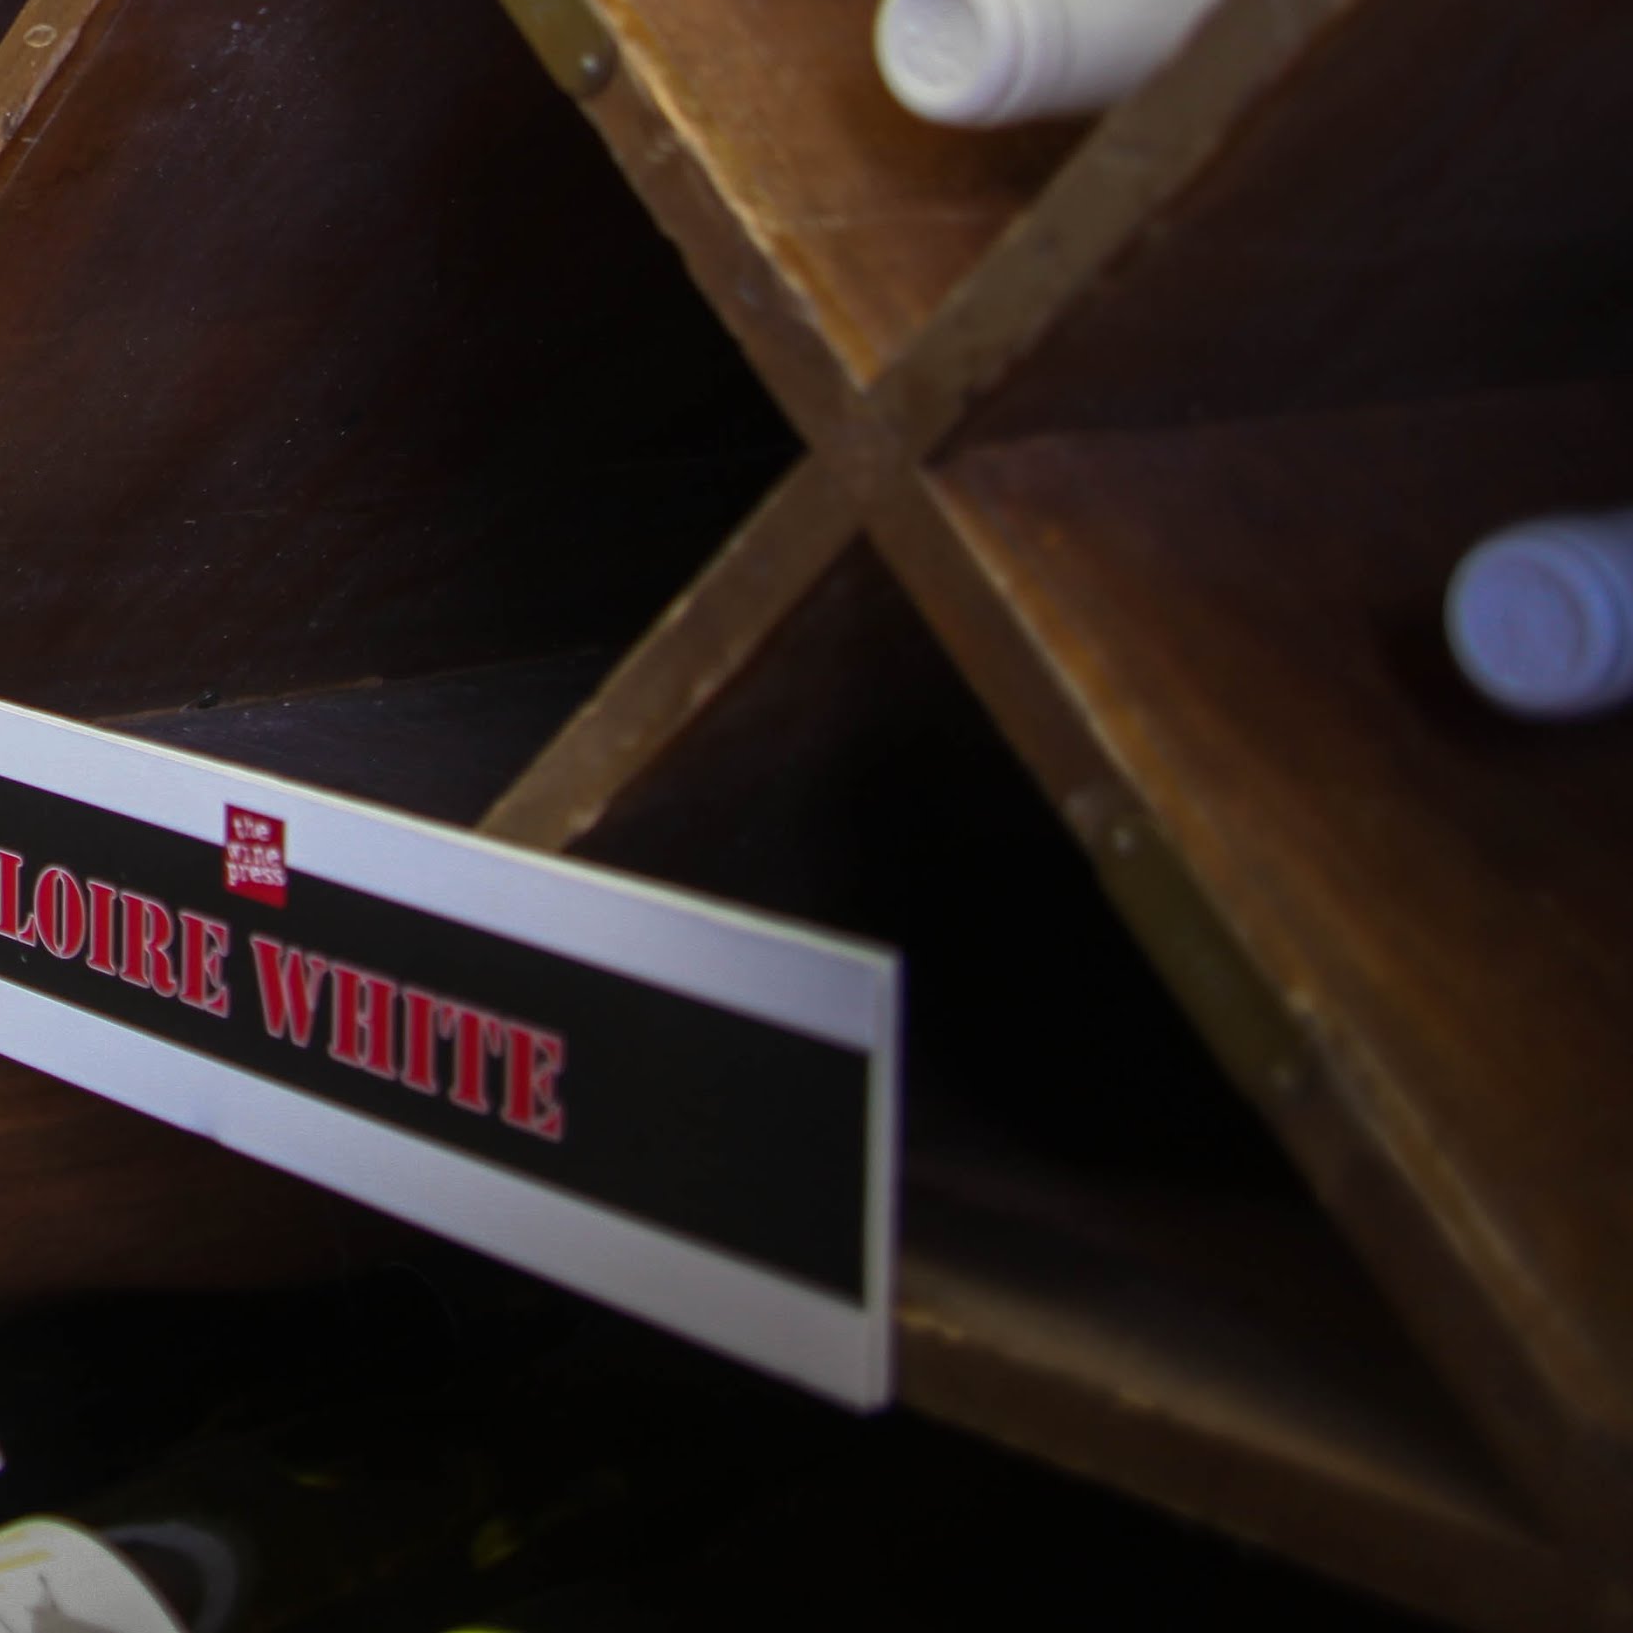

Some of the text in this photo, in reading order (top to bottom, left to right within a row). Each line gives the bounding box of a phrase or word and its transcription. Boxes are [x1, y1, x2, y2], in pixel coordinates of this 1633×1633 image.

[233, 814, 272, 843] the
[226, 843, 282, 868] wine
[225, 861, 287, 888] press
[249, 933, 566, 1143] WHITE
